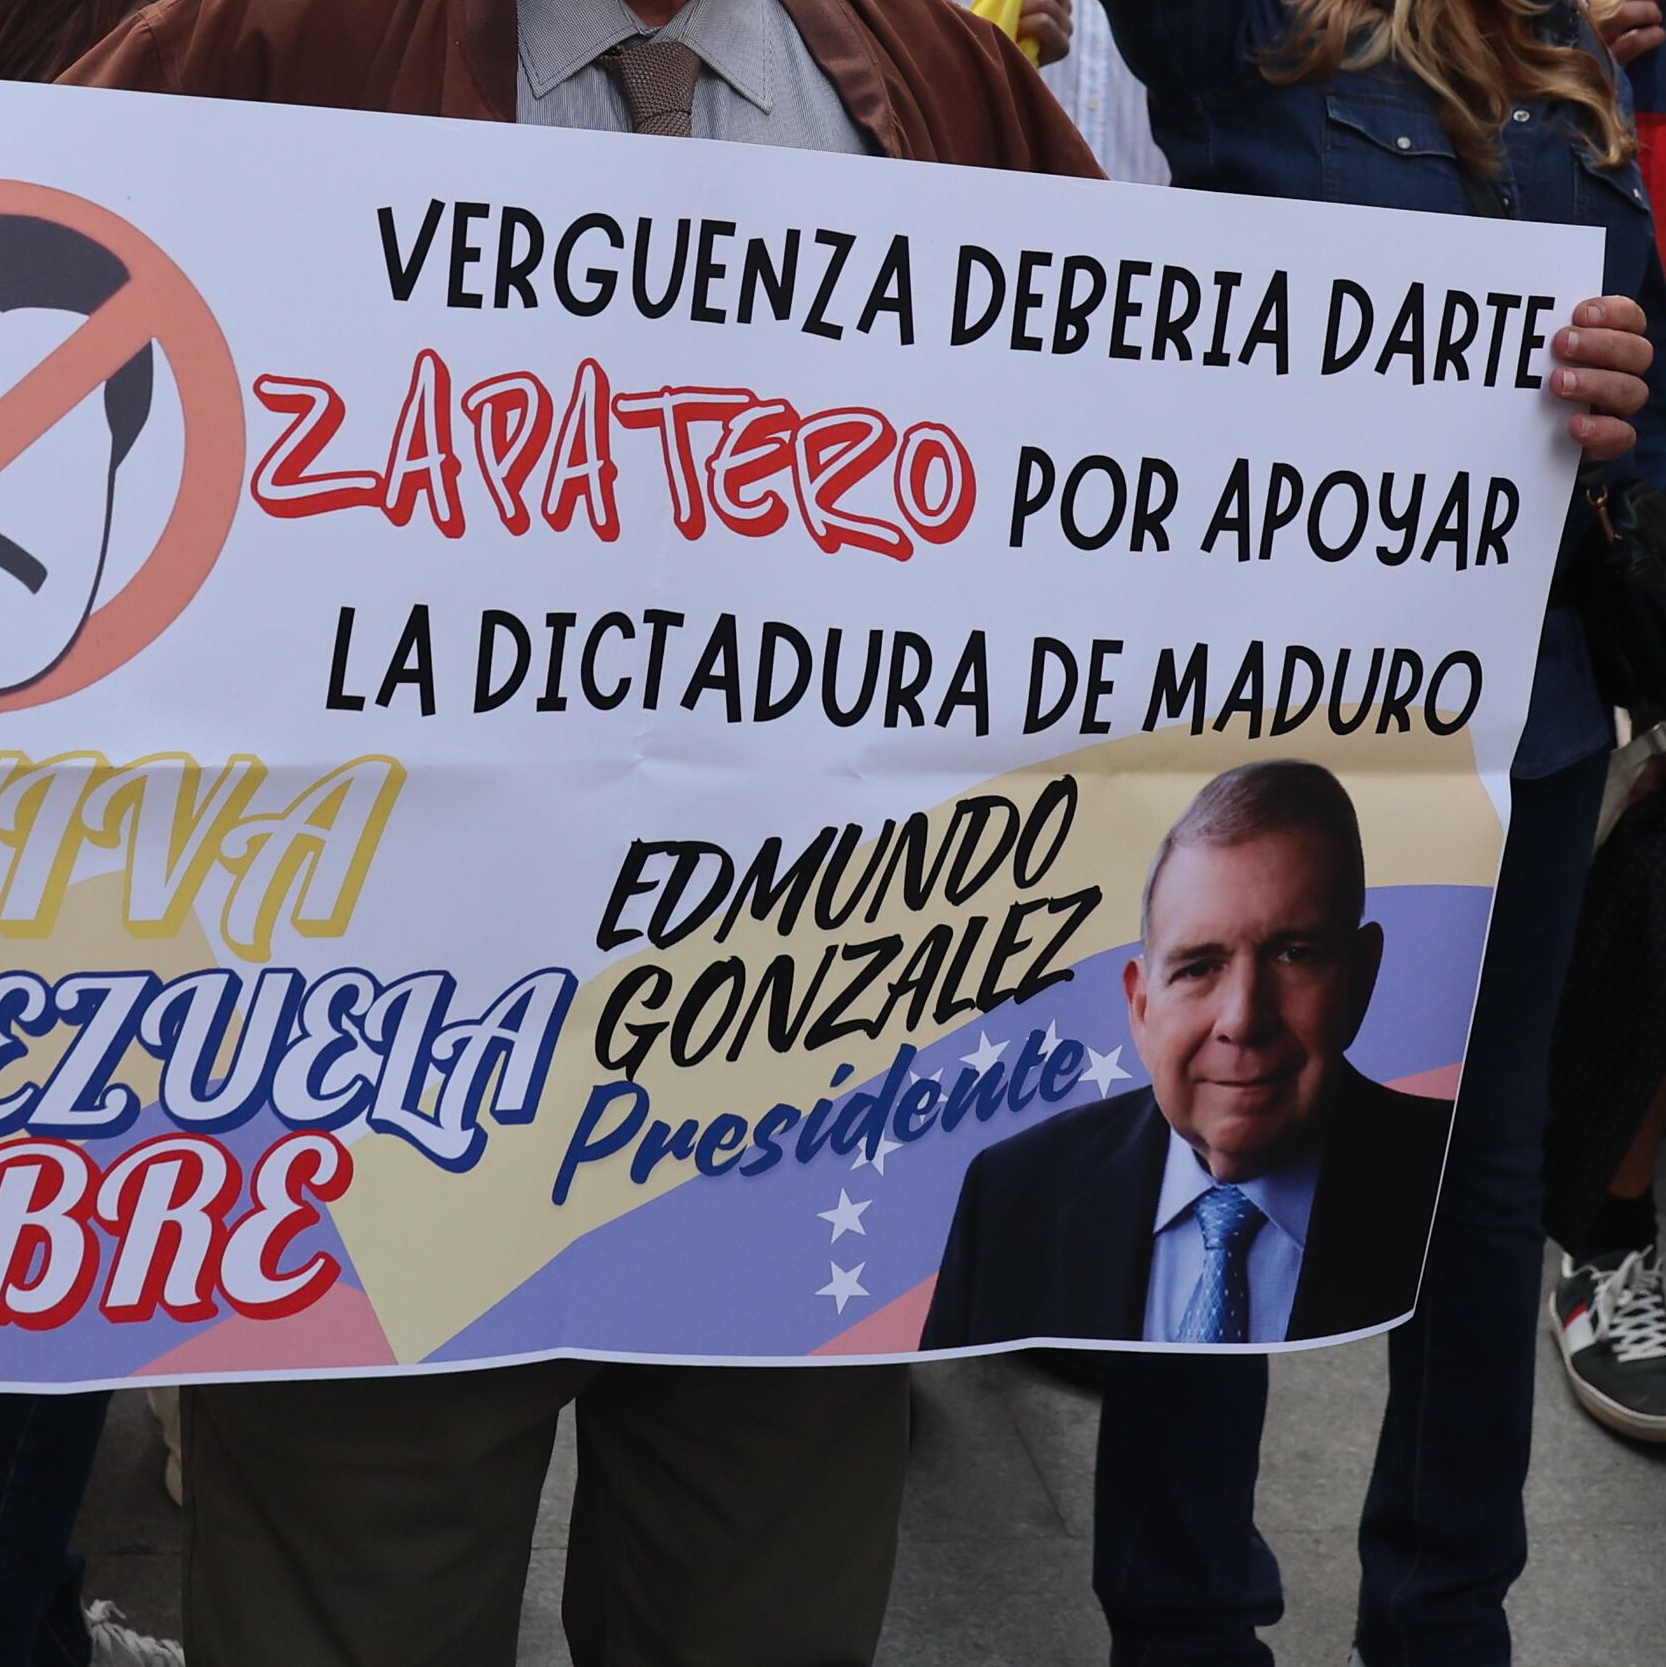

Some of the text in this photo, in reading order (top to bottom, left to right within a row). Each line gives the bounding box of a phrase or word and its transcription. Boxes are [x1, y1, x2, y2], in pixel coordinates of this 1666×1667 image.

[377, 198, 1556, 390] VERGUENZA DEBERIA DARTE
[251, 347, 1520, 571] ZAPATERO POR APOYAR
[325, 603, 1483, 740] LA DICTADURA DE MADURO
[595, 773, 1079, 952] EDMUNDO
[594, 885, 1104, 1080] GONZALEZ
[551, 1028, 1085, 1206] Presidente
